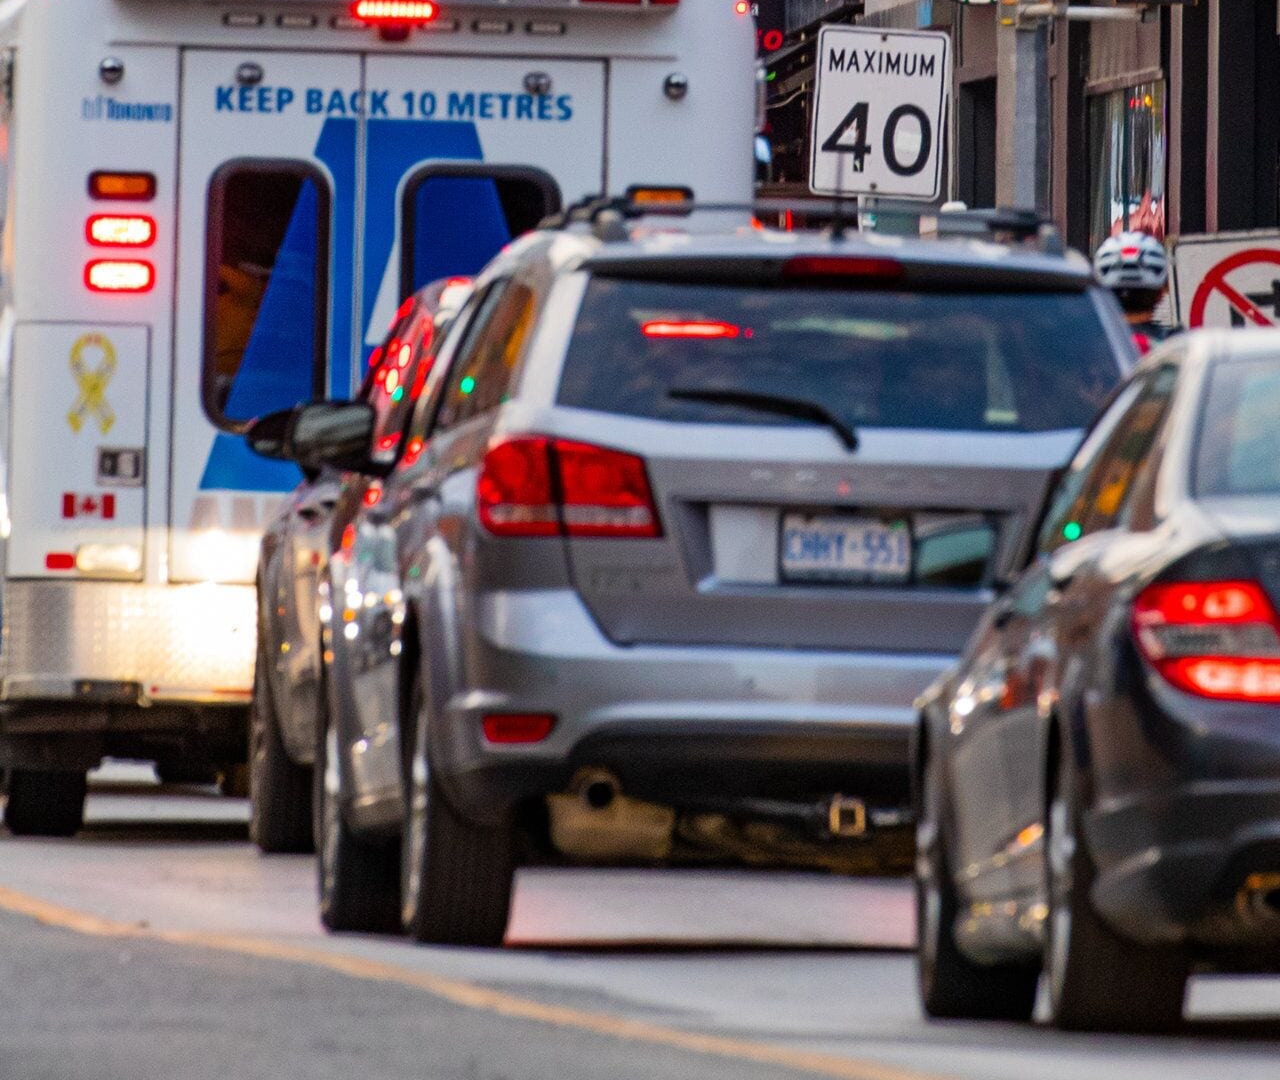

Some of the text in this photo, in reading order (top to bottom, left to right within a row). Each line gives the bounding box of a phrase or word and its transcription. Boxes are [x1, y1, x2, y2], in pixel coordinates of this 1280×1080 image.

[829, 48, 936, 77] MAXIMUM
[215, 85, 573, 121] KEEP BACK 10 METRES
[821, 101, 932, 177] 40
